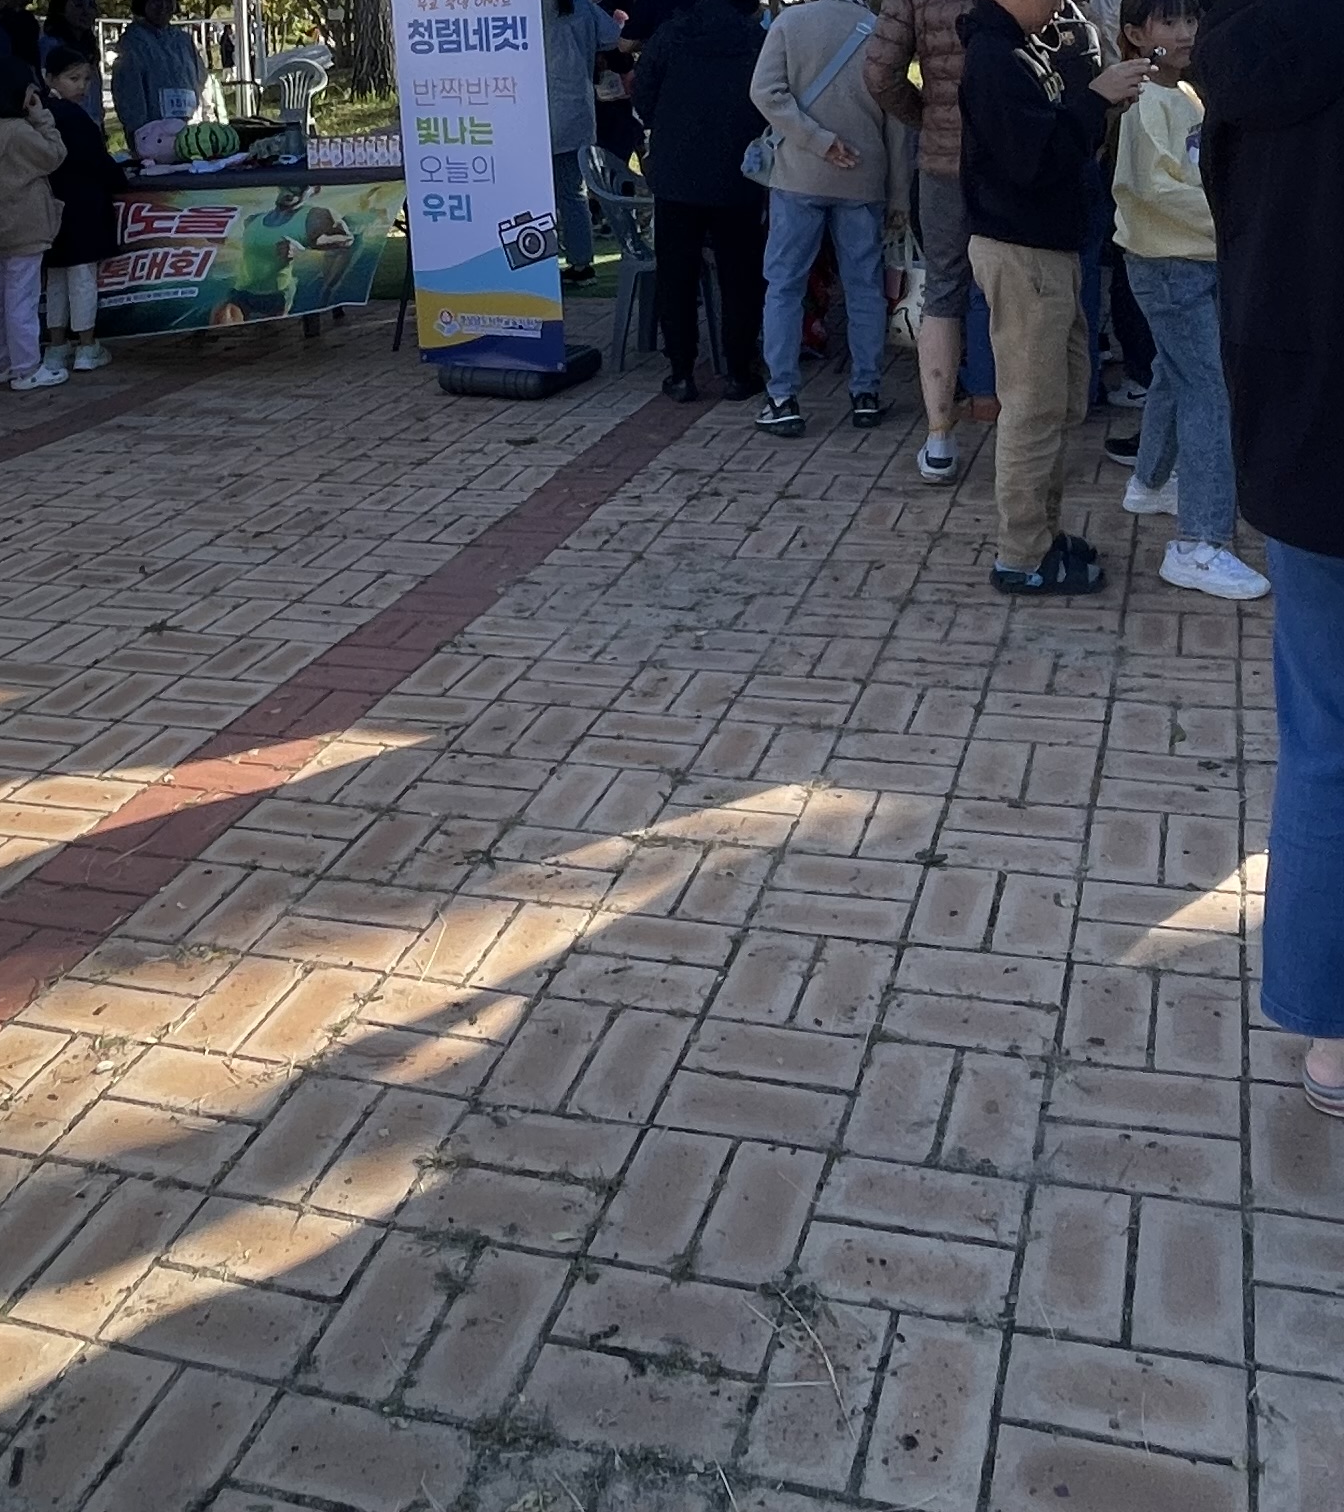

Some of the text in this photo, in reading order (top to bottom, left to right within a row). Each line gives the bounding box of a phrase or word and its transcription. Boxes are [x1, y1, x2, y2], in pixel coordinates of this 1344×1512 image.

[407, 16, 529, 55] 청렴네컷!
[412, 76, 518, 107] 반짝반짝
[416, 116, 494, 146] 빛나는
[419, 155, 496, 185] 오늘의
[422, 193, 473, 223] 우리
[115, 202, 241, 245] 노을
